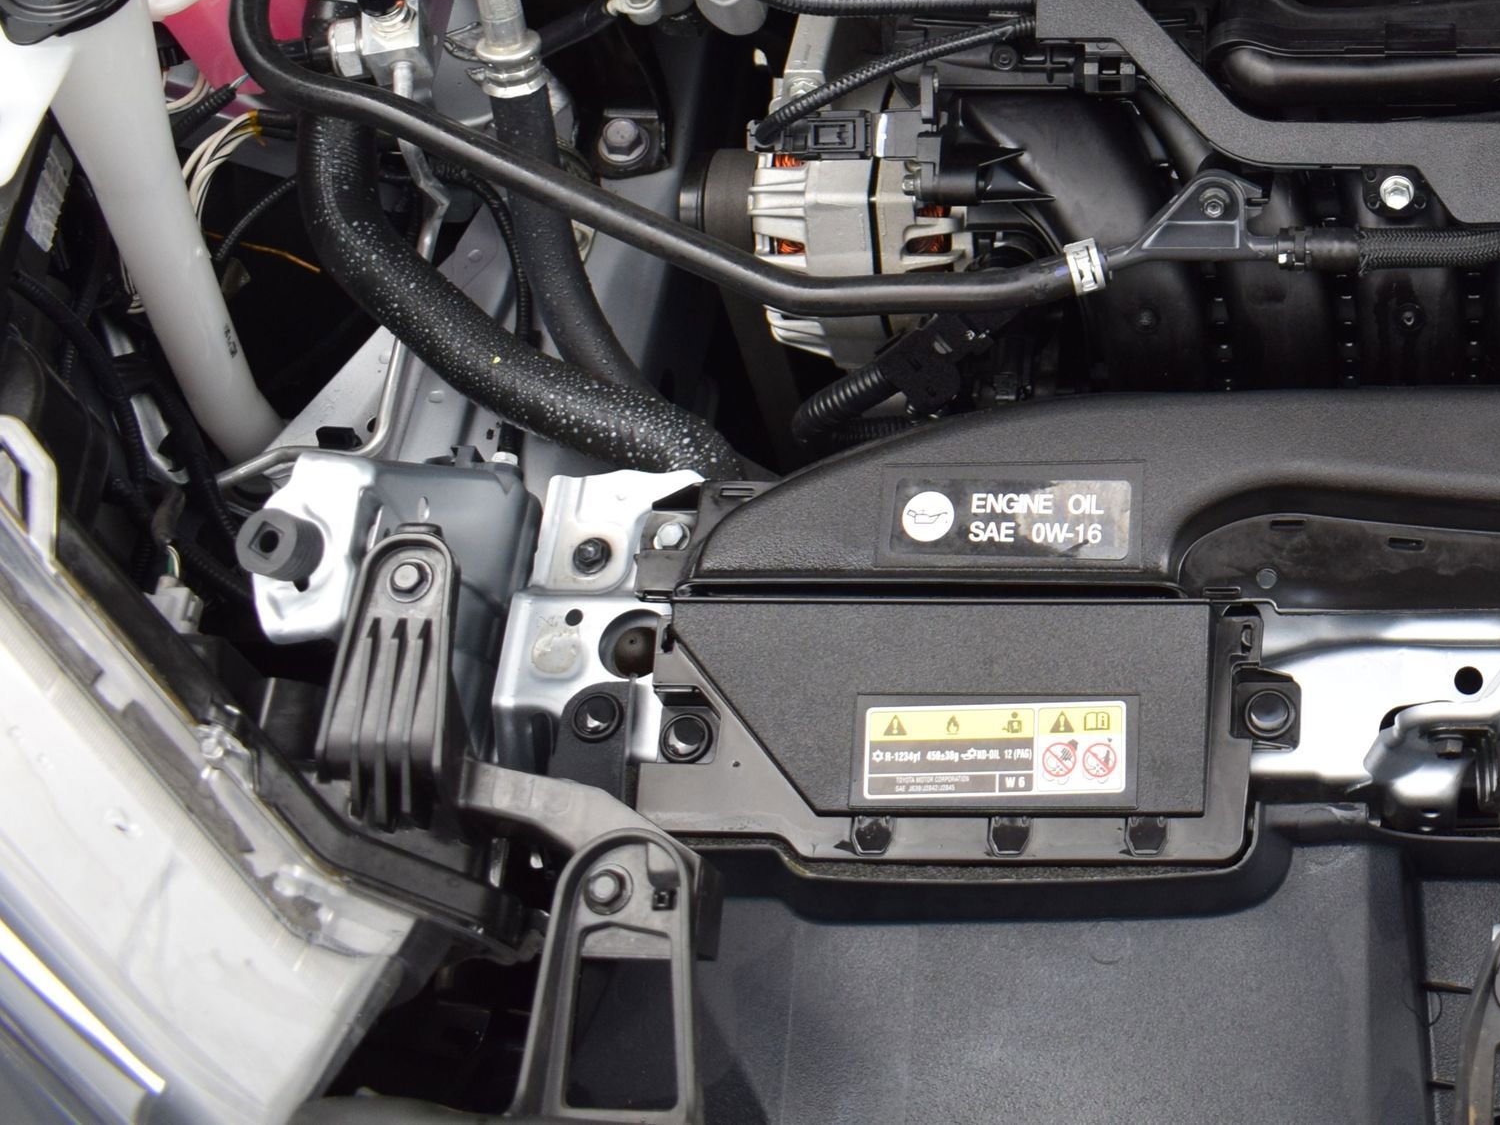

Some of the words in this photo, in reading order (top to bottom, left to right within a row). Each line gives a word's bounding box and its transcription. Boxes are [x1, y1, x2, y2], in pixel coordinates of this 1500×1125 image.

[970, 493, 1054, 515] ENGINE
[1068, 493, 1105, 515] OIL
[968, 521, 1015, 543] SAE
[1031, 522, 1103, 545] 0W-16
[1005, 777, 1016, 788] W
[1018, 776, 1026, 788] 6
